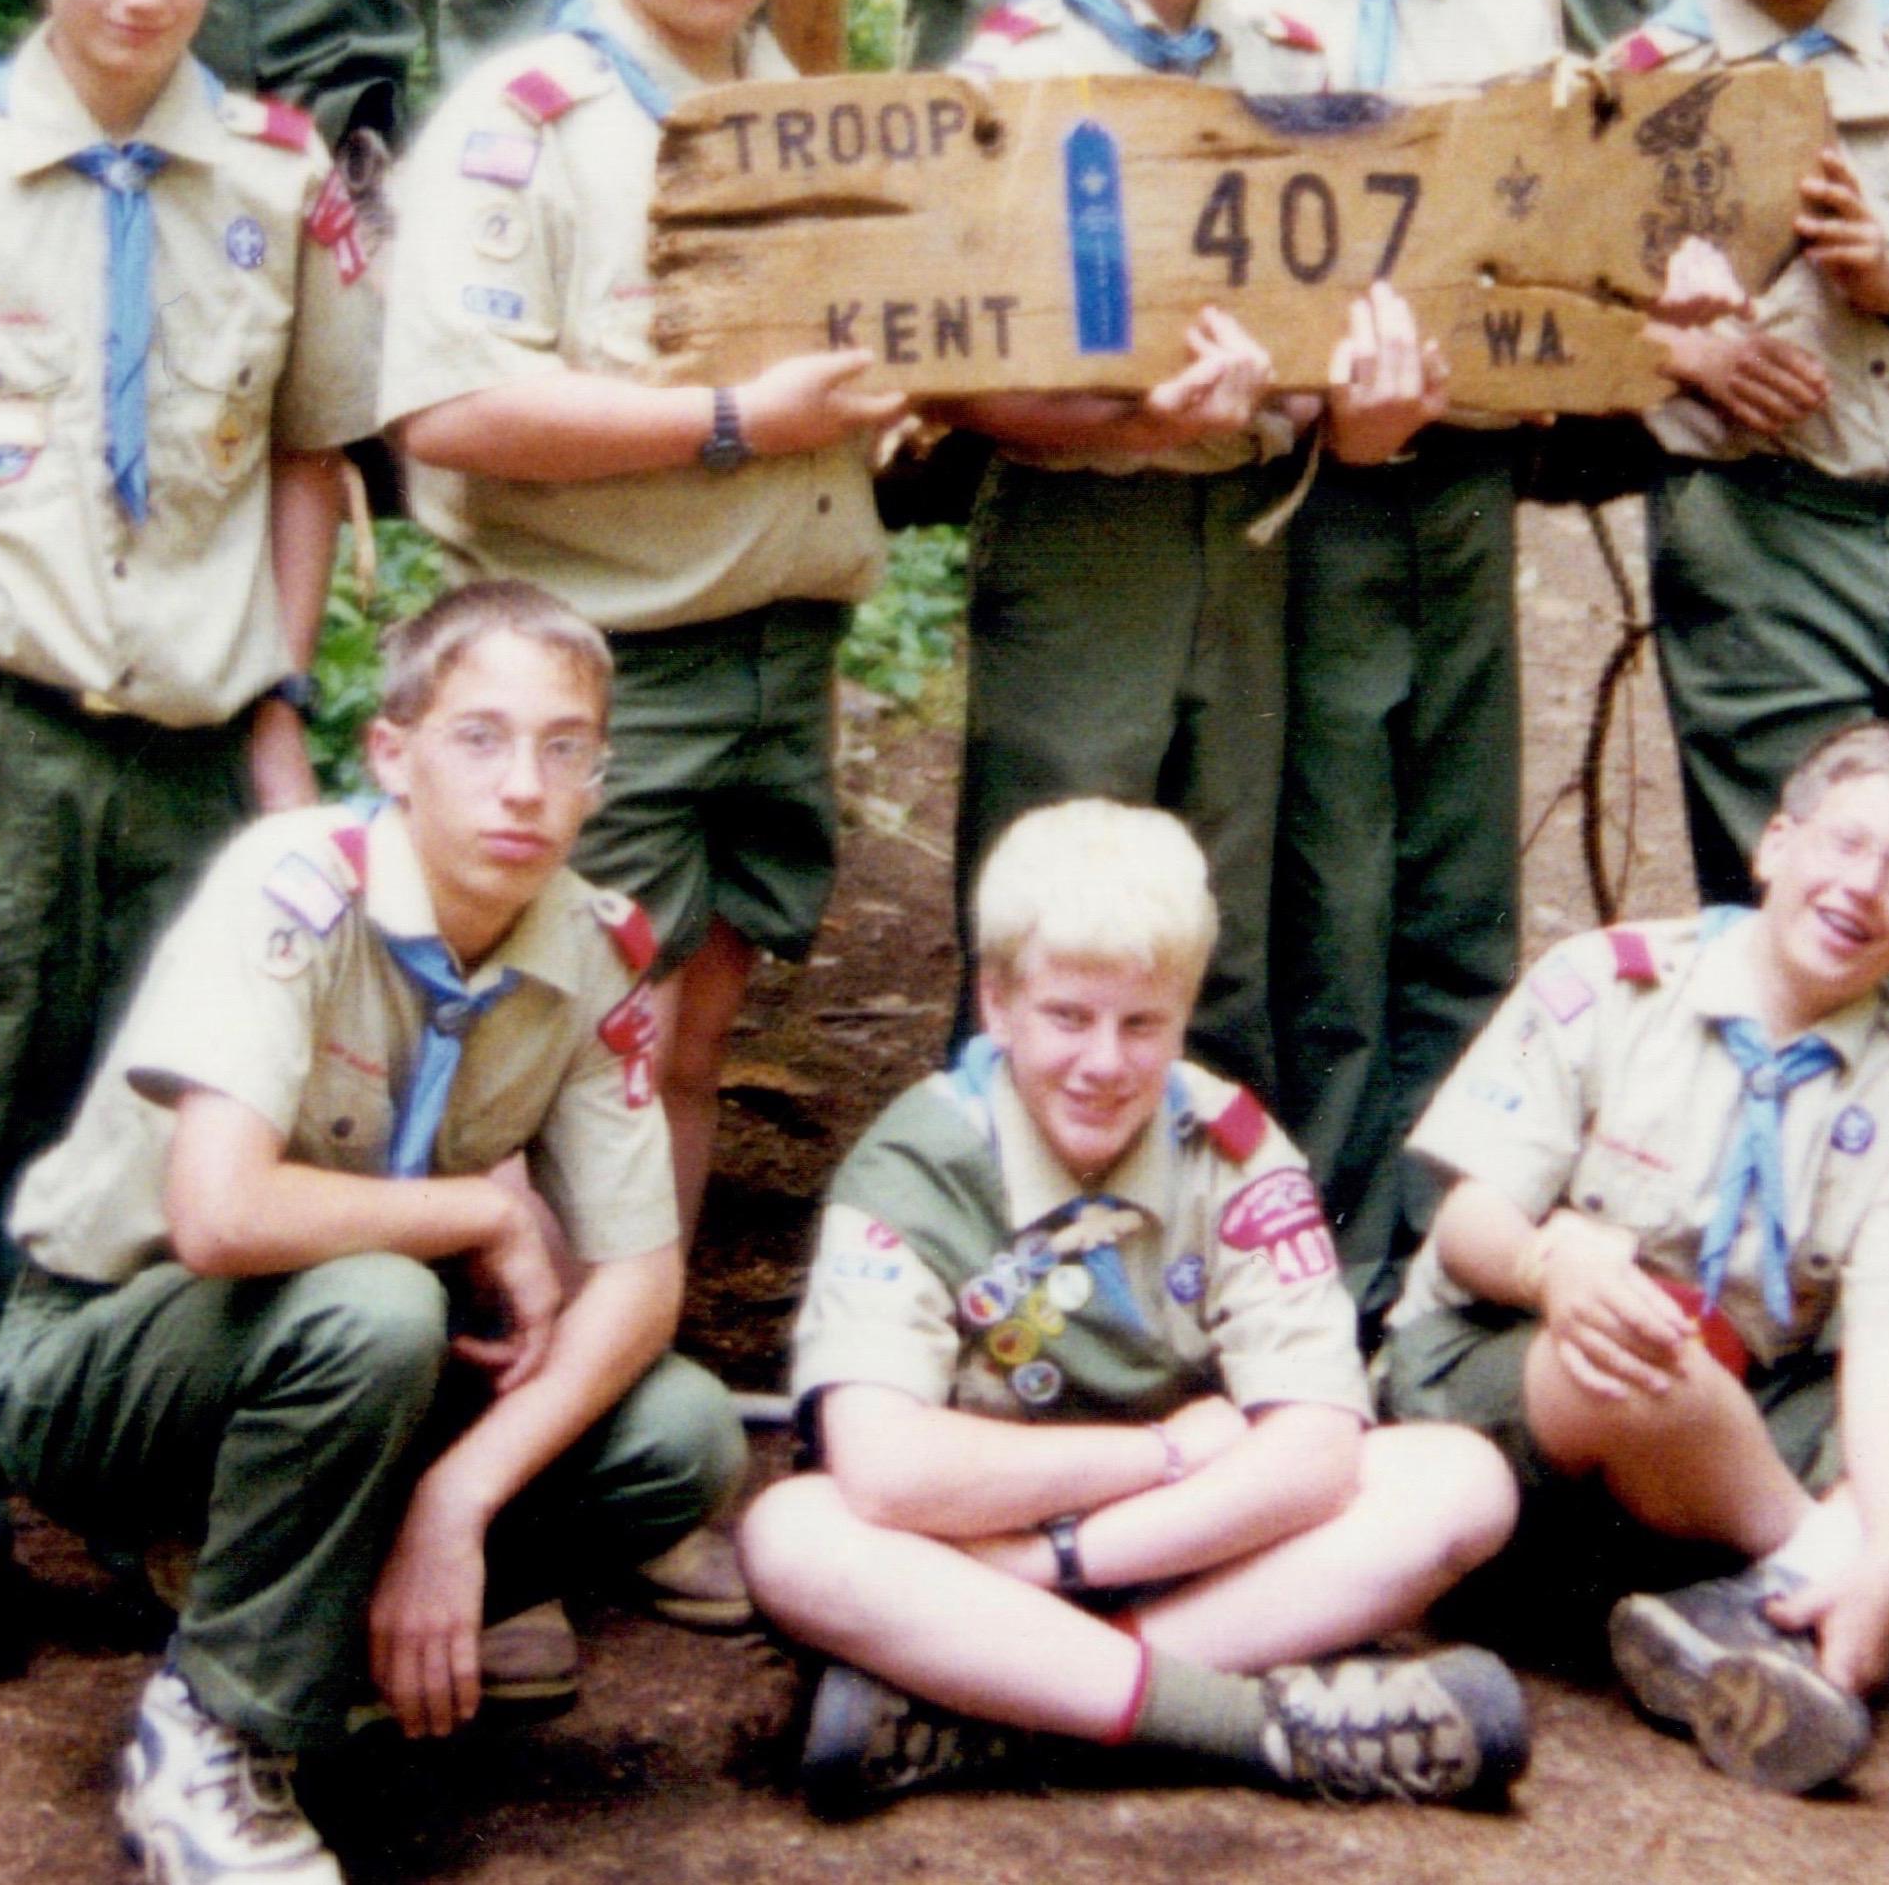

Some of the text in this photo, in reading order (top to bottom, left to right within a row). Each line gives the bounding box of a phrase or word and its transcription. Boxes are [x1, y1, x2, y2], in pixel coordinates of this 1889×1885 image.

[721, 98, 967, 173] TROOP
[1192, 169, 1422, 287] 407
[826, 294, 1021, 364] KENT
